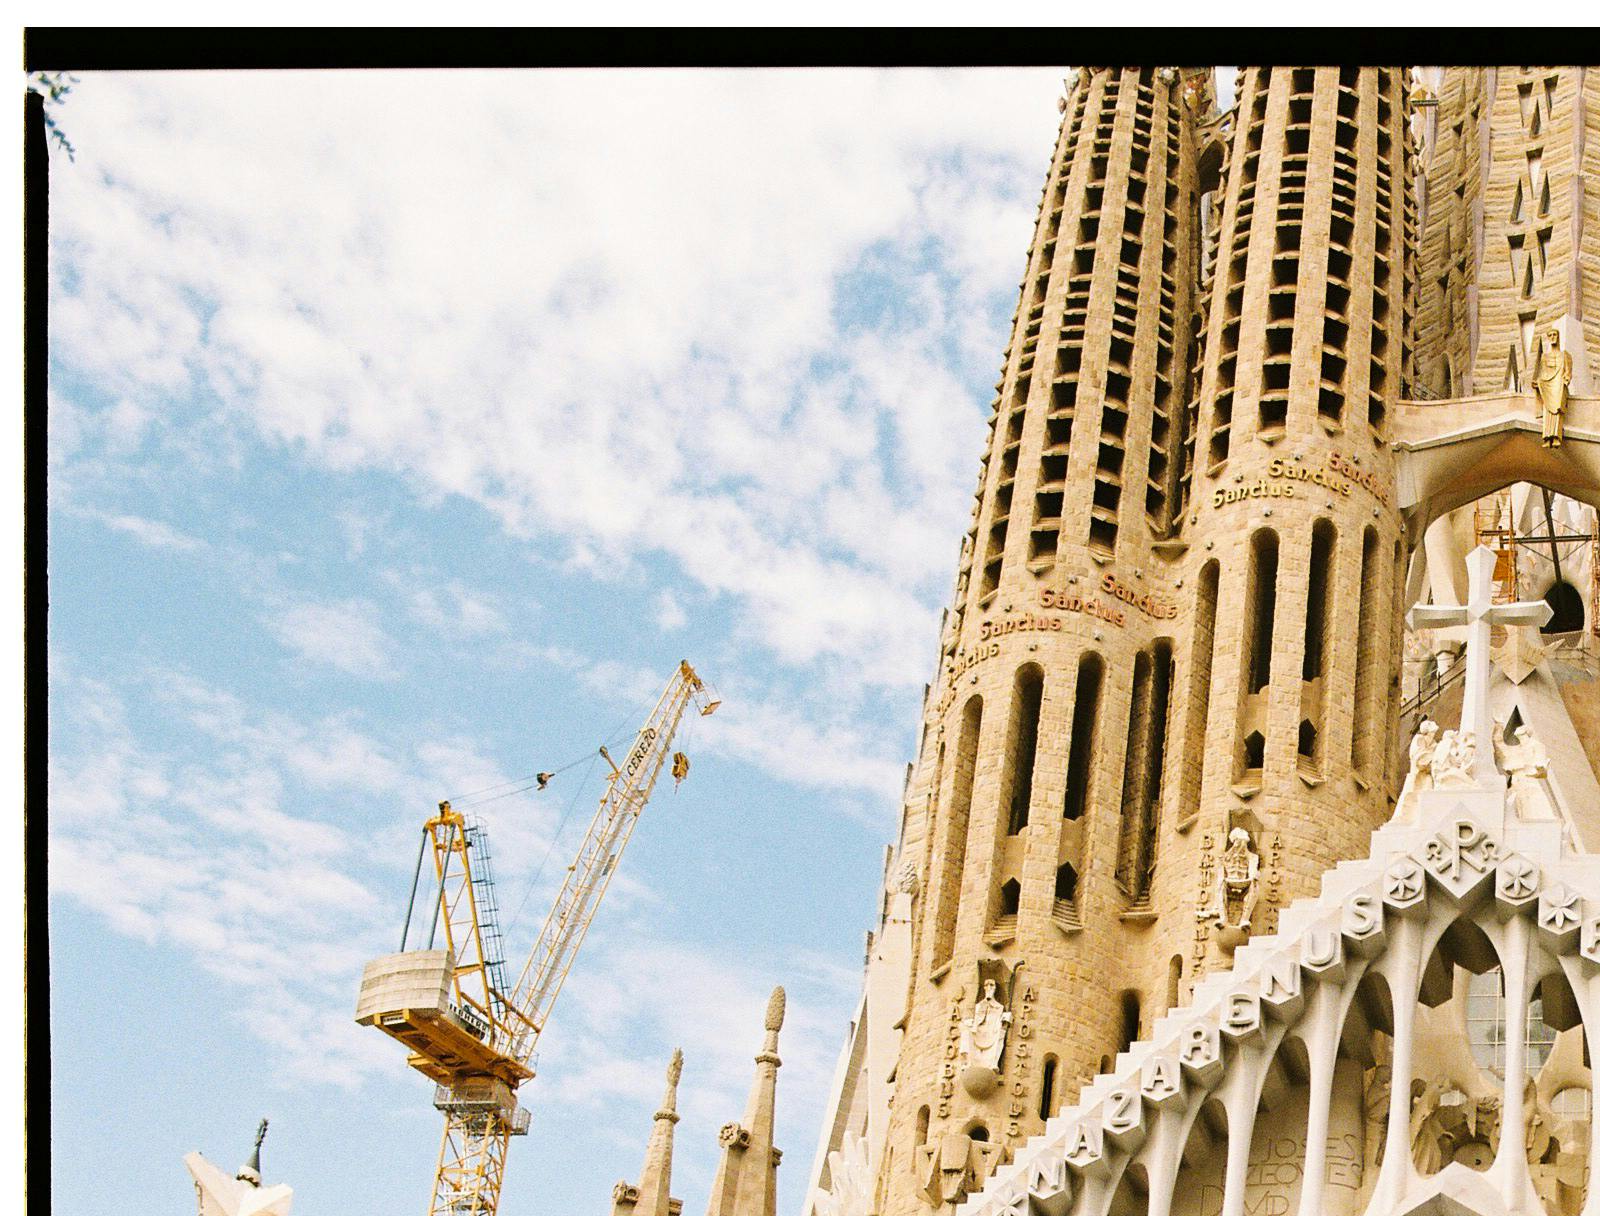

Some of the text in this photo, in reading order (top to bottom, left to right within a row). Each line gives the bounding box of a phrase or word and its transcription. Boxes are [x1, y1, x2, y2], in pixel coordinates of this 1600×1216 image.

[1213, 480, 1295, 509] Sanctus
[1268, 459, 1352, 496] Sanctus
[1040, 588, 1126, 627] Sanctus
[981, 613, 1062, 641] Sanctus
[627, 727, 656, 777] CEREZO
[1030, 895, 1377, 1194] NAZARENUS
